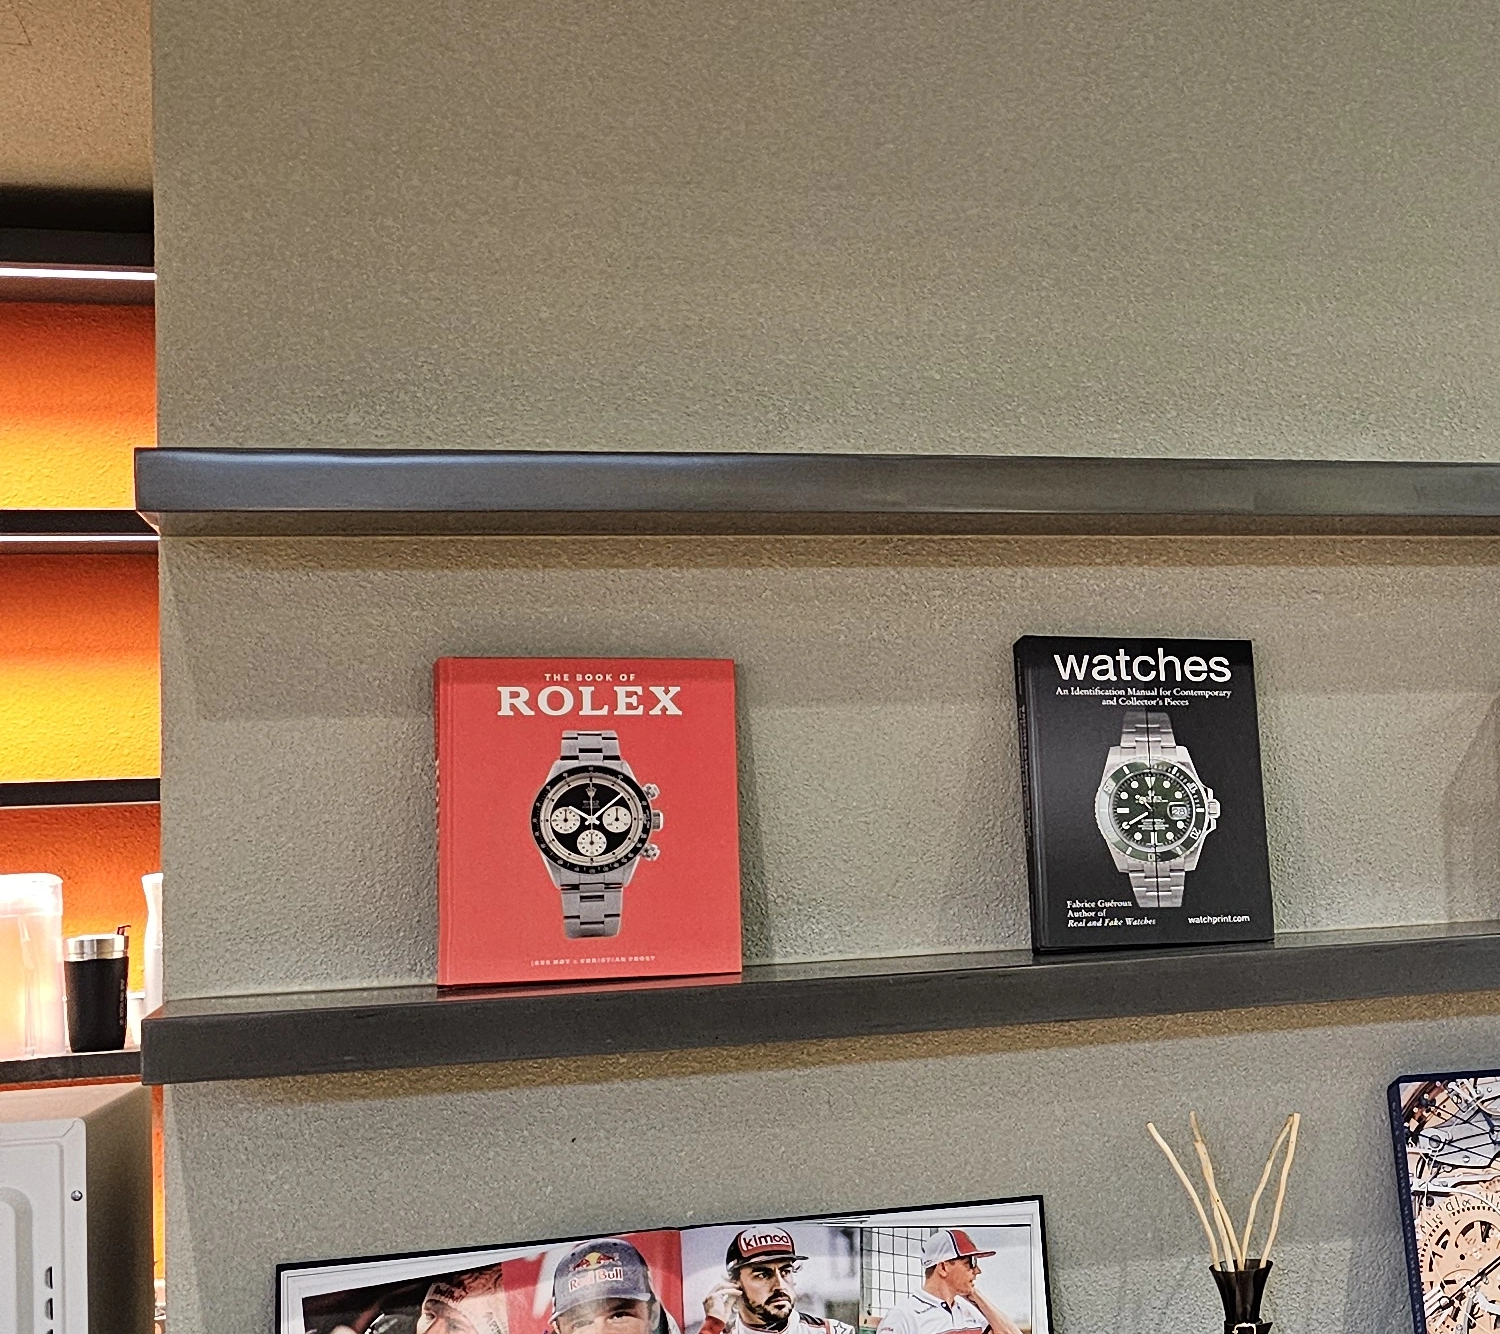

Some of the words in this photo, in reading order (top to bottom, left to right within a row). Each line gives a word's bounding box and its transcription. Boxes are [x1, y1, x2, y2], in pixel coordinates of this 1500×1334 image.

[1053, 647, 1232, 683] watches
[544, 673, 569, 682] THE
[576, 673, 613, 682] BOOK
[619, 673, 636, 682] OF
[1055, 687, 1069, 696] An
[1070, 687, 1126, 697] Identification
[1127, 687, 1158, 697] Manual
[1159, 687, 1172, 697] for
[1173, 688, 1232, 699] Contemporary
[496, 685, 683, 716] ROLEX
[1102, 697, 1117, 706] and
[1118, 697, 1163, 707] Collector's
[1164, 698, 1190, 707] Pieces
[1171, 807, 1186, 817] 28
[1067, 900, 1095, 908] Fabrice
[1067, 909, 1096, 918] Author
[1097, 909, 1107, 917] of
[1067, 919, 1086, 928] Real
[1087, 919, 1103, 928] and
[1104, 919, 1123, 927] Fake
[1125, 917, 1156, 927] Watches
[1188, 914, 1250, 925] watchprint.com
[599, 1268, 622, 1281] Bull
